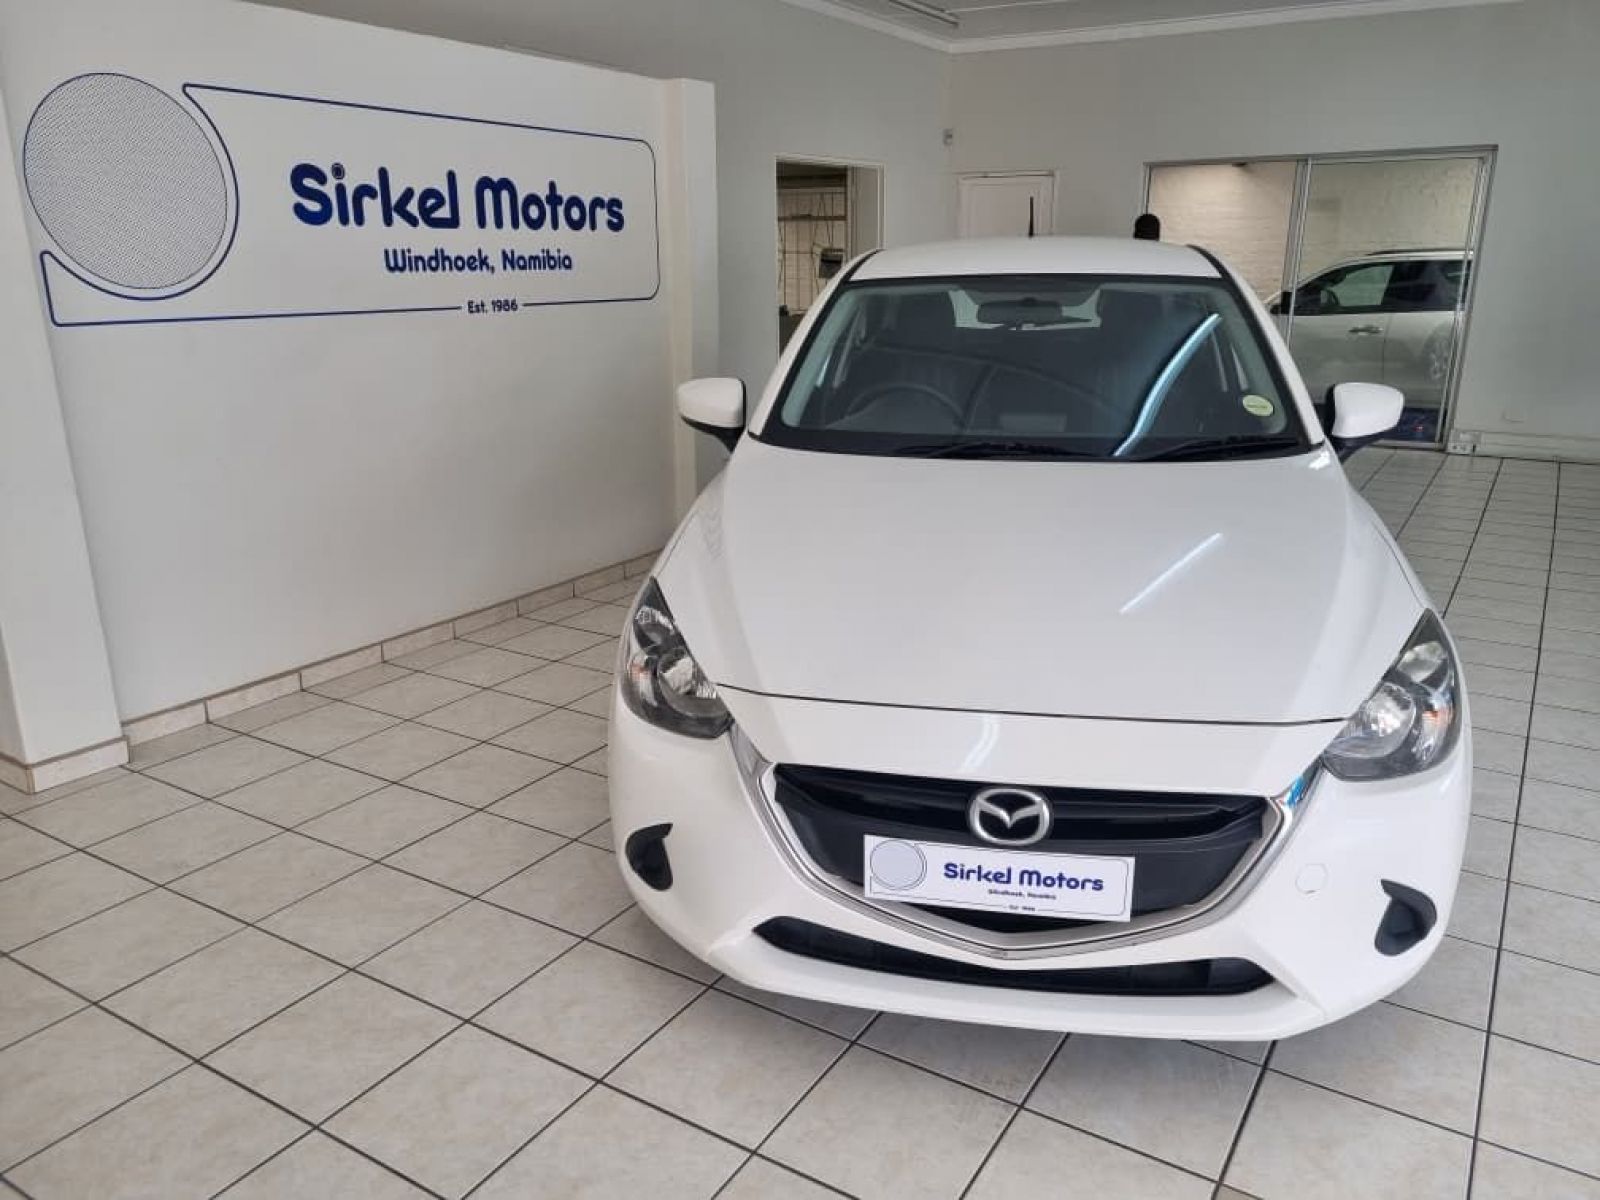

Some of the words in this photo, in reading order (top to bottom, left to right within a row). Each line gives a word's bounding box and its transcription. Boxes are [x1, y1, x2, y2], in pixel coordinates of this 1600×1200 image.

[290, 162, 460, 229] Sirkel
[474, 176, 625, 232] Motors
[384, 248, 496, 274] Windhoek,
[501, 250, 573, 272] Namibia
[467, 301, 488, 314] Est.
[491, 299, 518, 313] 1986
[943, 862, 1012, 885] Sirkel
[1019, 869, 1104, 891] Motors
